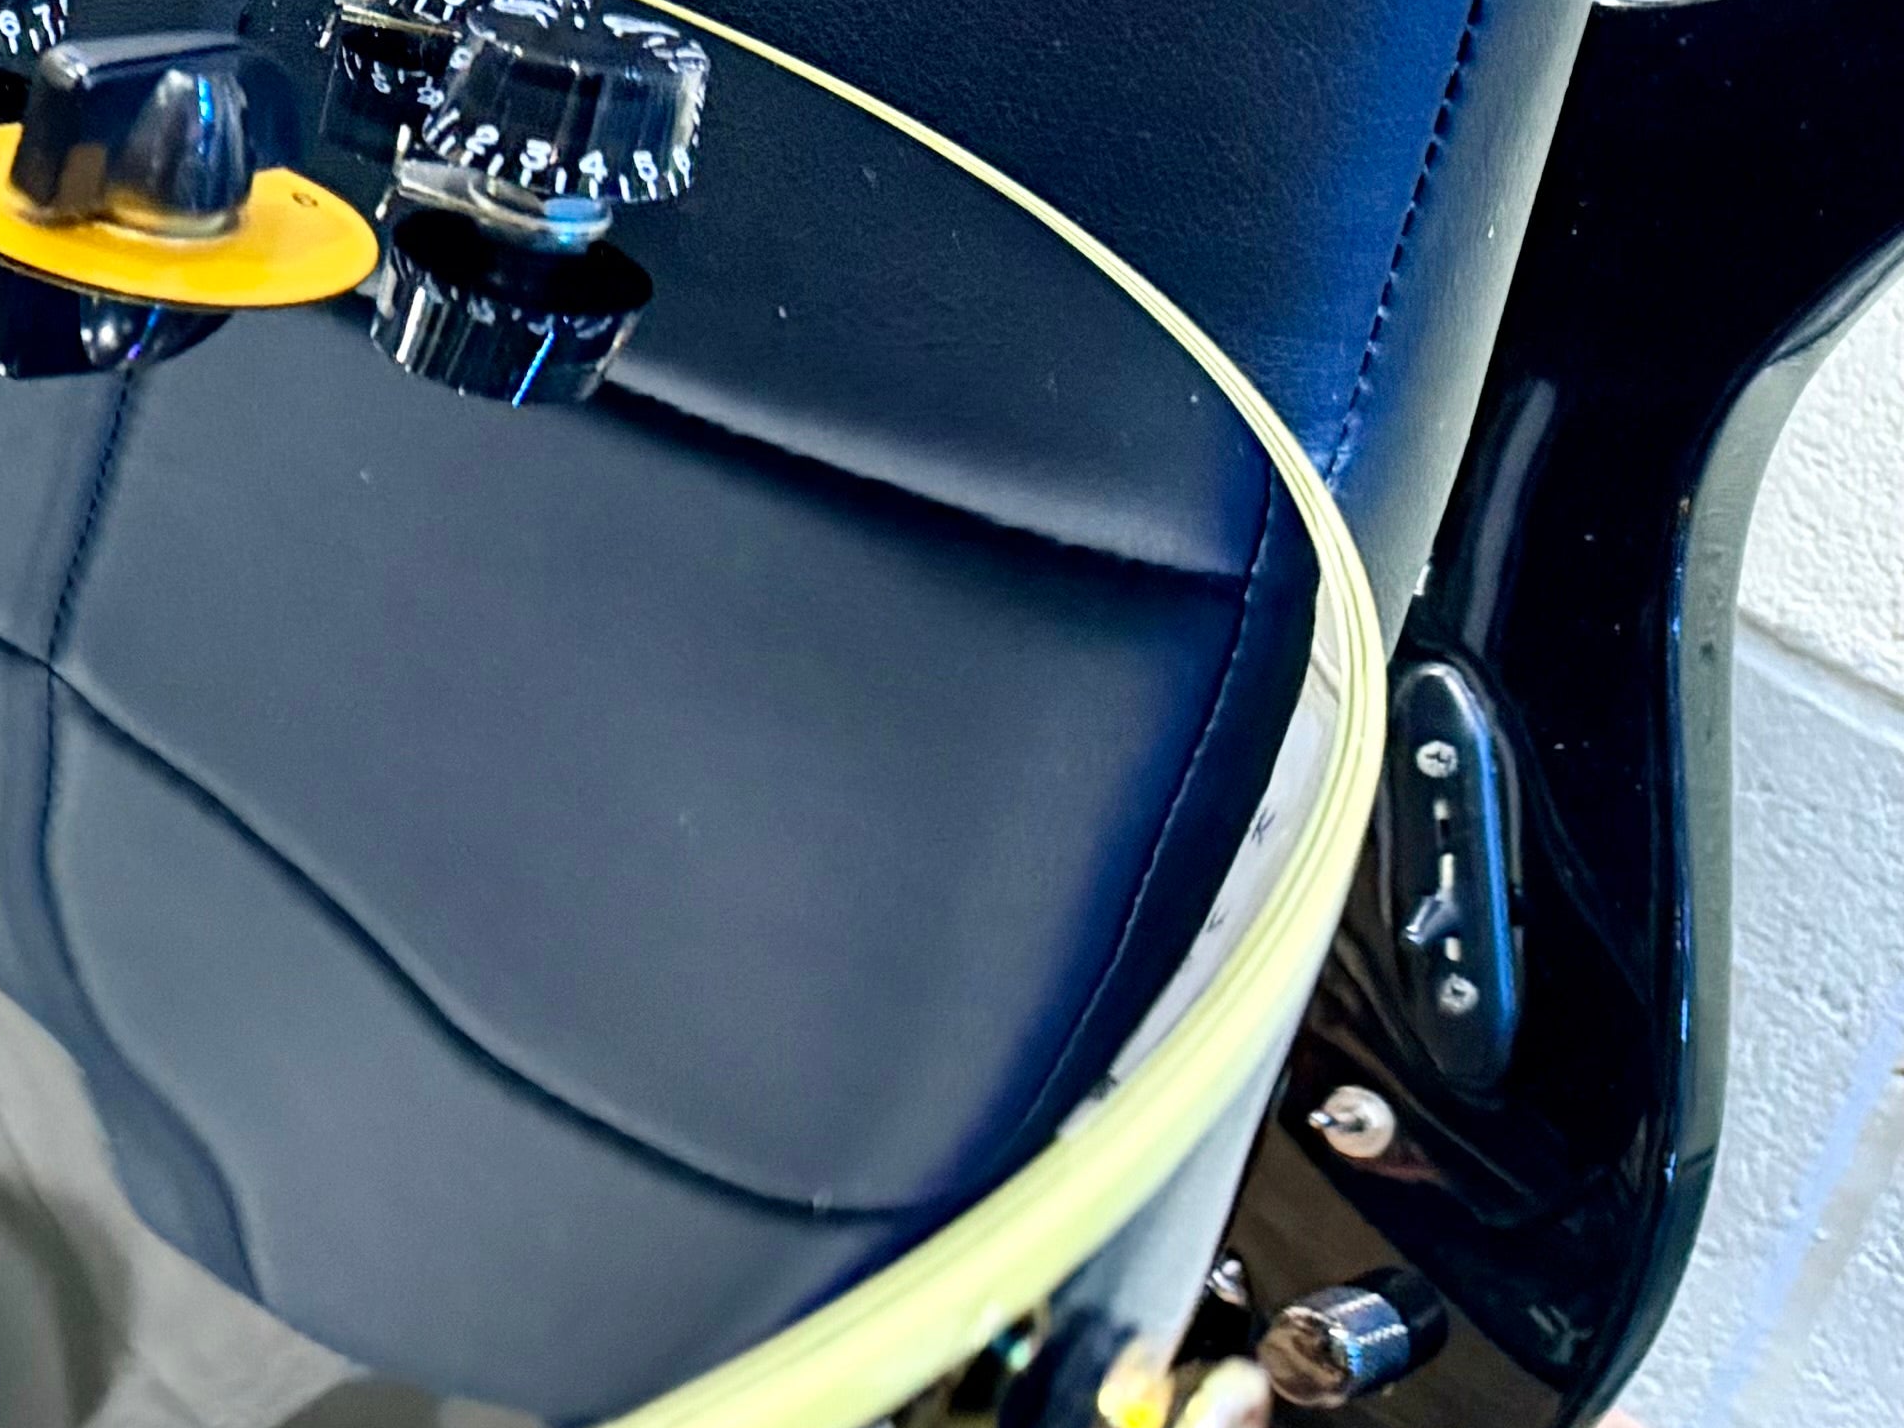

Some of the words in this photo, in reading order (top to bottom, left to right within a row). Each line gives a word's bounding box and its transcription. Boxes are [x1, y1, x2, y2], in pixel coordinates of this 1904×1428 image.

[465, 124, 500, 156] 2
[519, 138, 553, 171] 3
[579, 149, 607, 179] 4
[633, 149, 658, 182] 5
